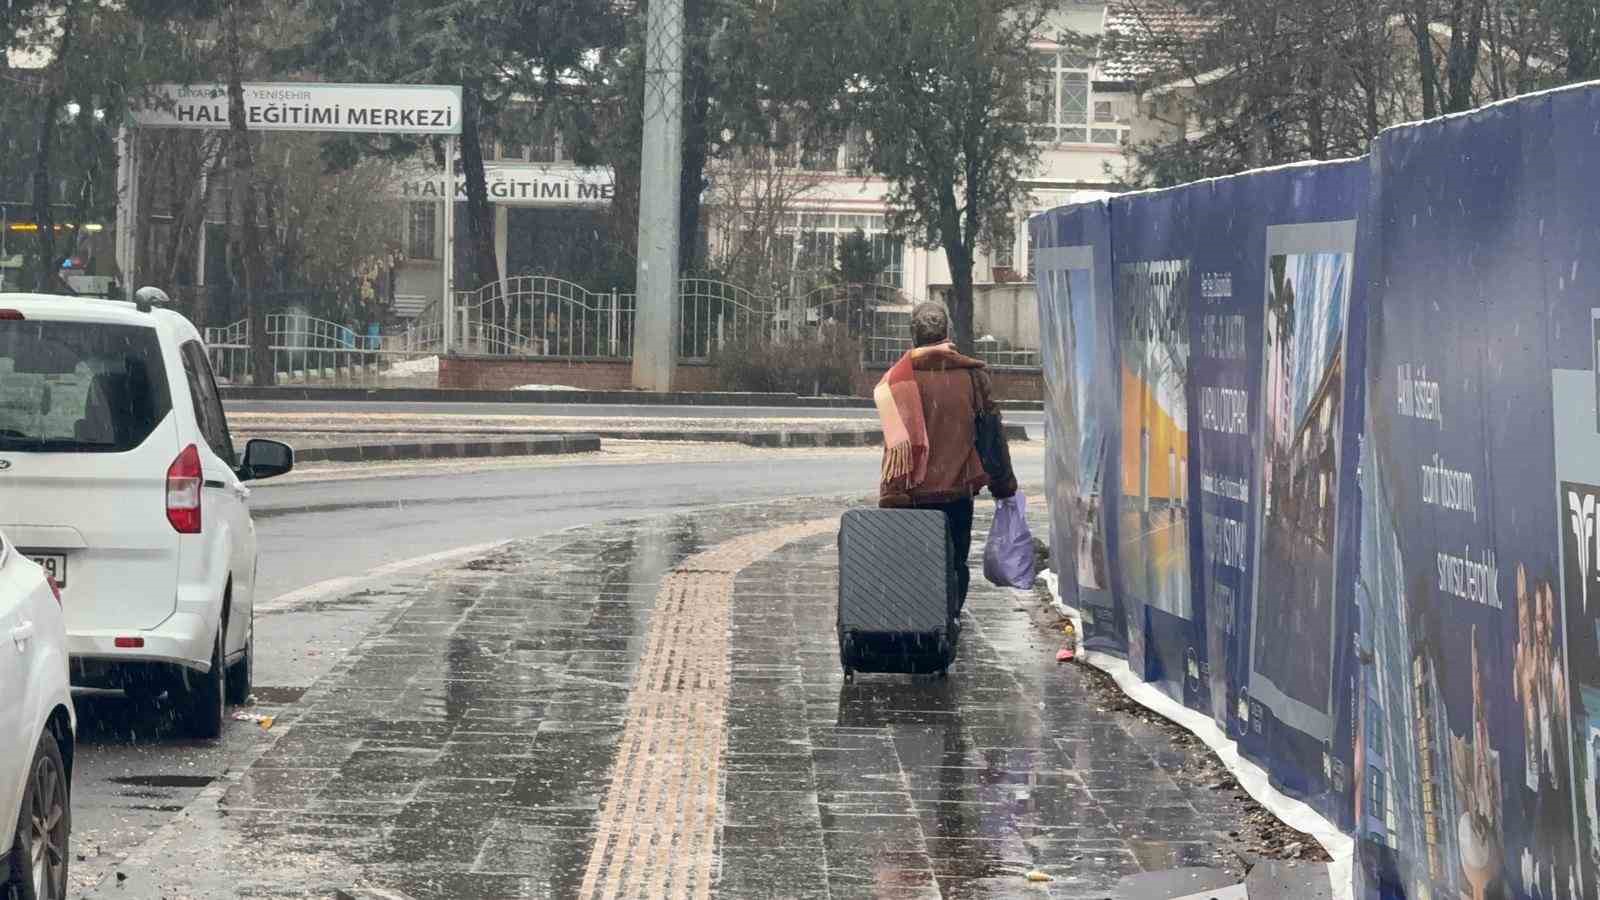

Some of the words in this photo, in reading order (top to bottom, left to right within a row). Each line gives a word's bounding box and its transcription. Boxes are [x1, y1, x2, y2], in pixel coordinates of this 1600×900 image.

[178, 104, 230, 122] HAL
[249, 103, 340, 125] EĞİTİMİ
[347, 105, 452, 127] MERKEZİ
[486, 178, 570, 198] ĞİTİMİ
[577, 183, 616, 199] ME
